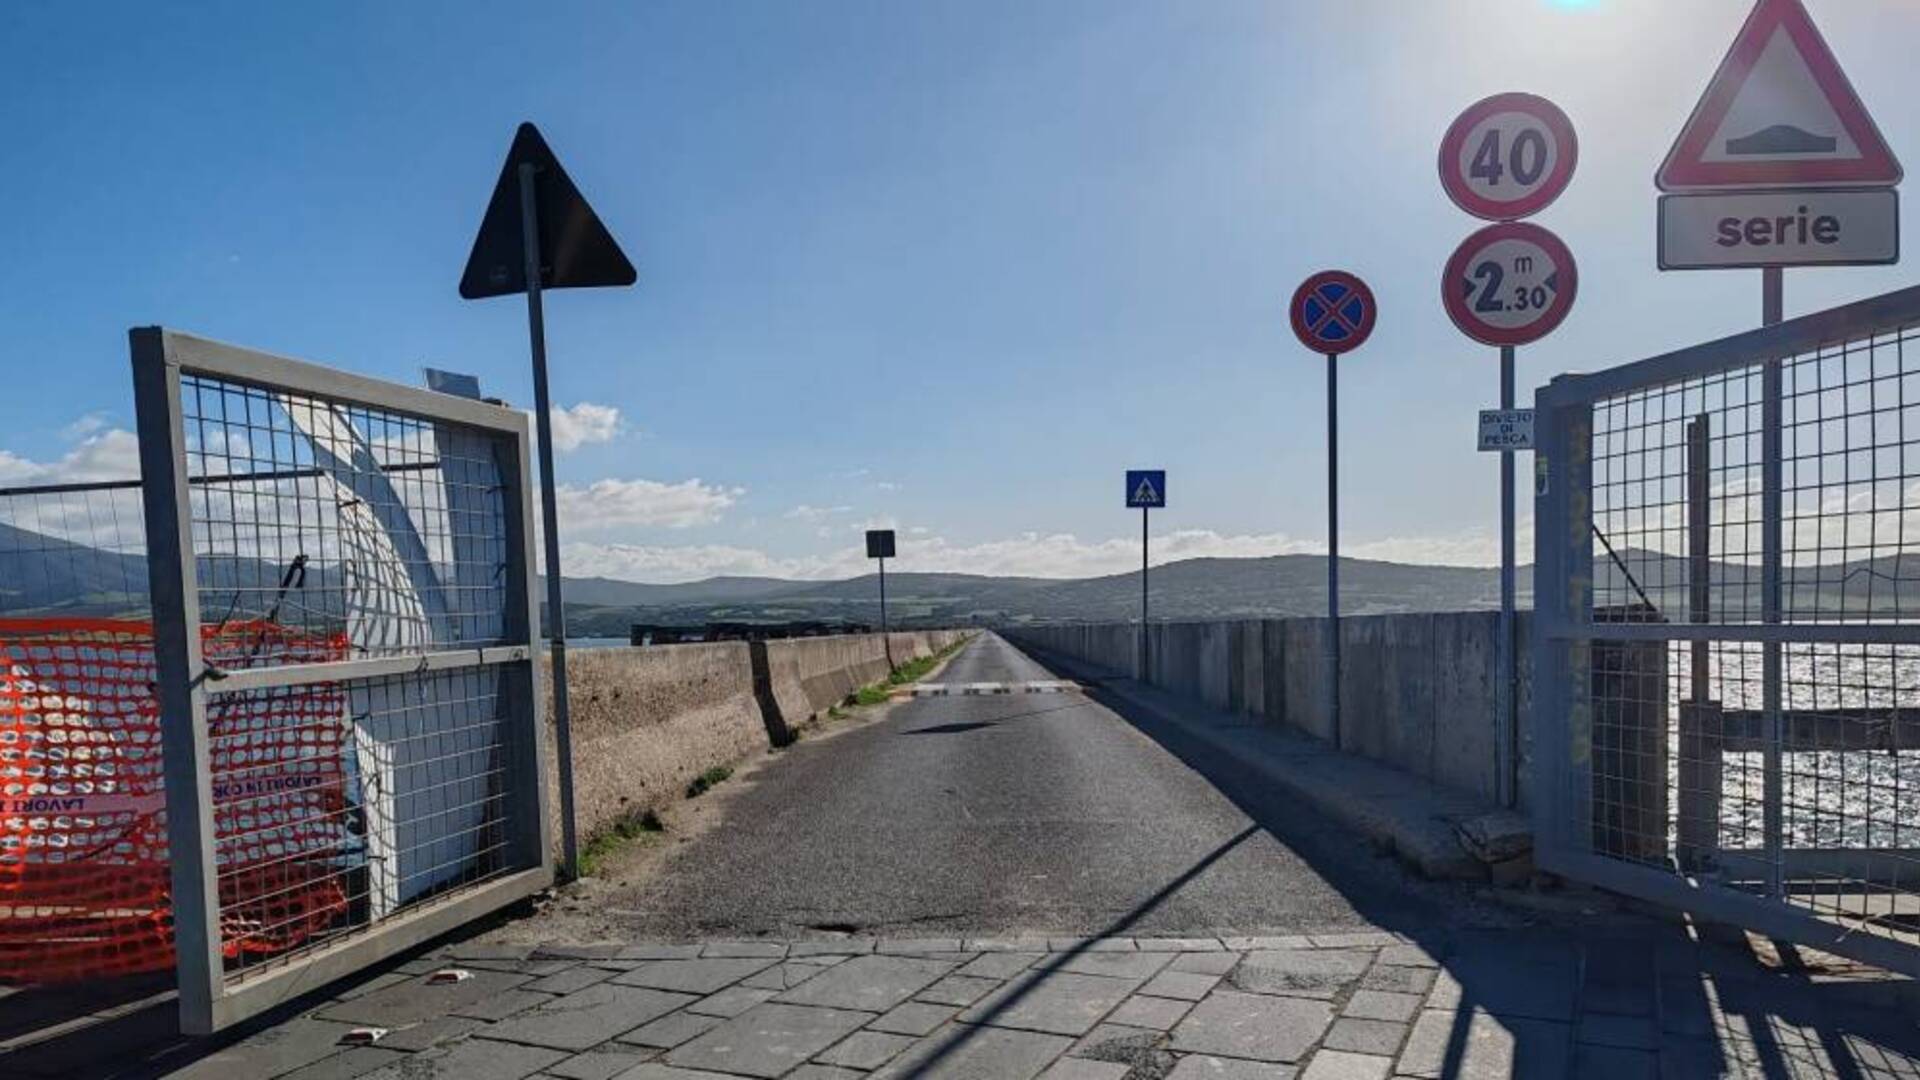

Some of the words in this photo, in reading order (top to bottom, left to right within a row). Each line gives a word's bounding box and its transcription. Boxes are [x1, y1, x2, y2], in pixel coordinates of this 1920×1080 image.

[1469, 128, 1548, 187] 40
[1715, 206, 1841, 248] serie
[1514, 255, 1533, 273] m
[1481, 413, 1533, 424] DIVIETO
[1501, 424, 1514, 433] DI
[1484, 434, 1528, 445] PESCA
[13, 798, 85, 813] LAVORI
